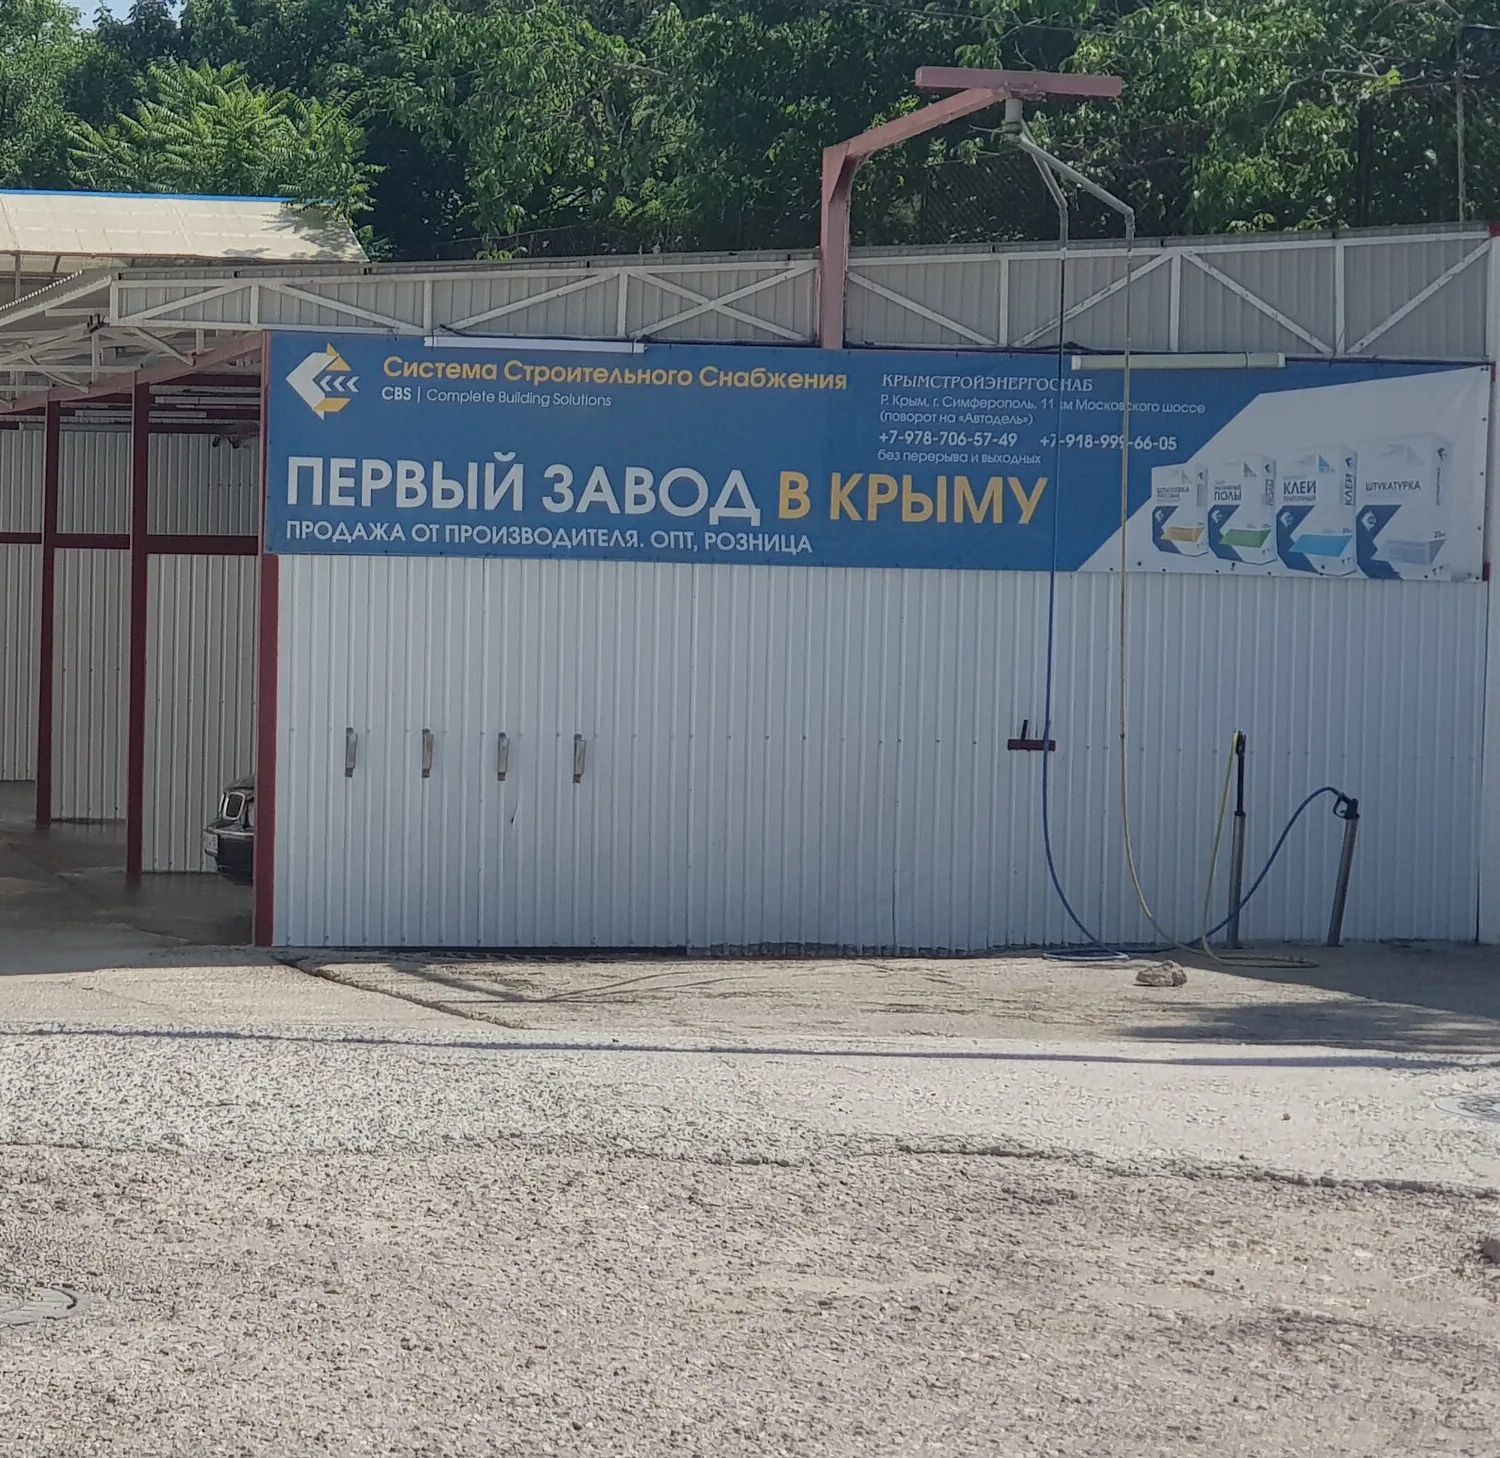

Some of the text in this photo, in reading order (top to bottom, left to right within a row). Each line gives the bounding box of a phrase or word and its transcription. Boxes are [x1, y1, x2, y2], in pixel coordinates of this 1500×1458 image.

[383, 356, 848, 390] Система Строительного Снабжения
[882, 374, 1093, 392] КРЫМСТРОЙЭНЕРГОСНАБ
[381, 386, 412, 401] CBS
[426, 388, 495, 405] Complete
[499, 391, 550, 408] Building
[552, 393, 612, 407] Solutions
[1041, 398, 1054, 409] 11
[1162, 404, 1206, 414] шоссе
[880, 411, 1033, 425] (поворот на «Автодель»)
[879, 430, 1178, 450] +7-978-706-57-49 +7-918-999-66-05
[877, 449, 1042, 465] без перерыва и выходных
[287, 451, 1048, 527] ПЕРВЫЙ ЗАВОД В КРЫМУ
[1365, 480, 1421, 492] ШТУКАТУРКА
[1214, 490, 1242, 501] ПОЛЫ
[286, 520, 813, 555] ПРОДАЖА ОТ ПРОИЗВОДИТЕЛЯ. ОПТ, РОЗНИЦА
